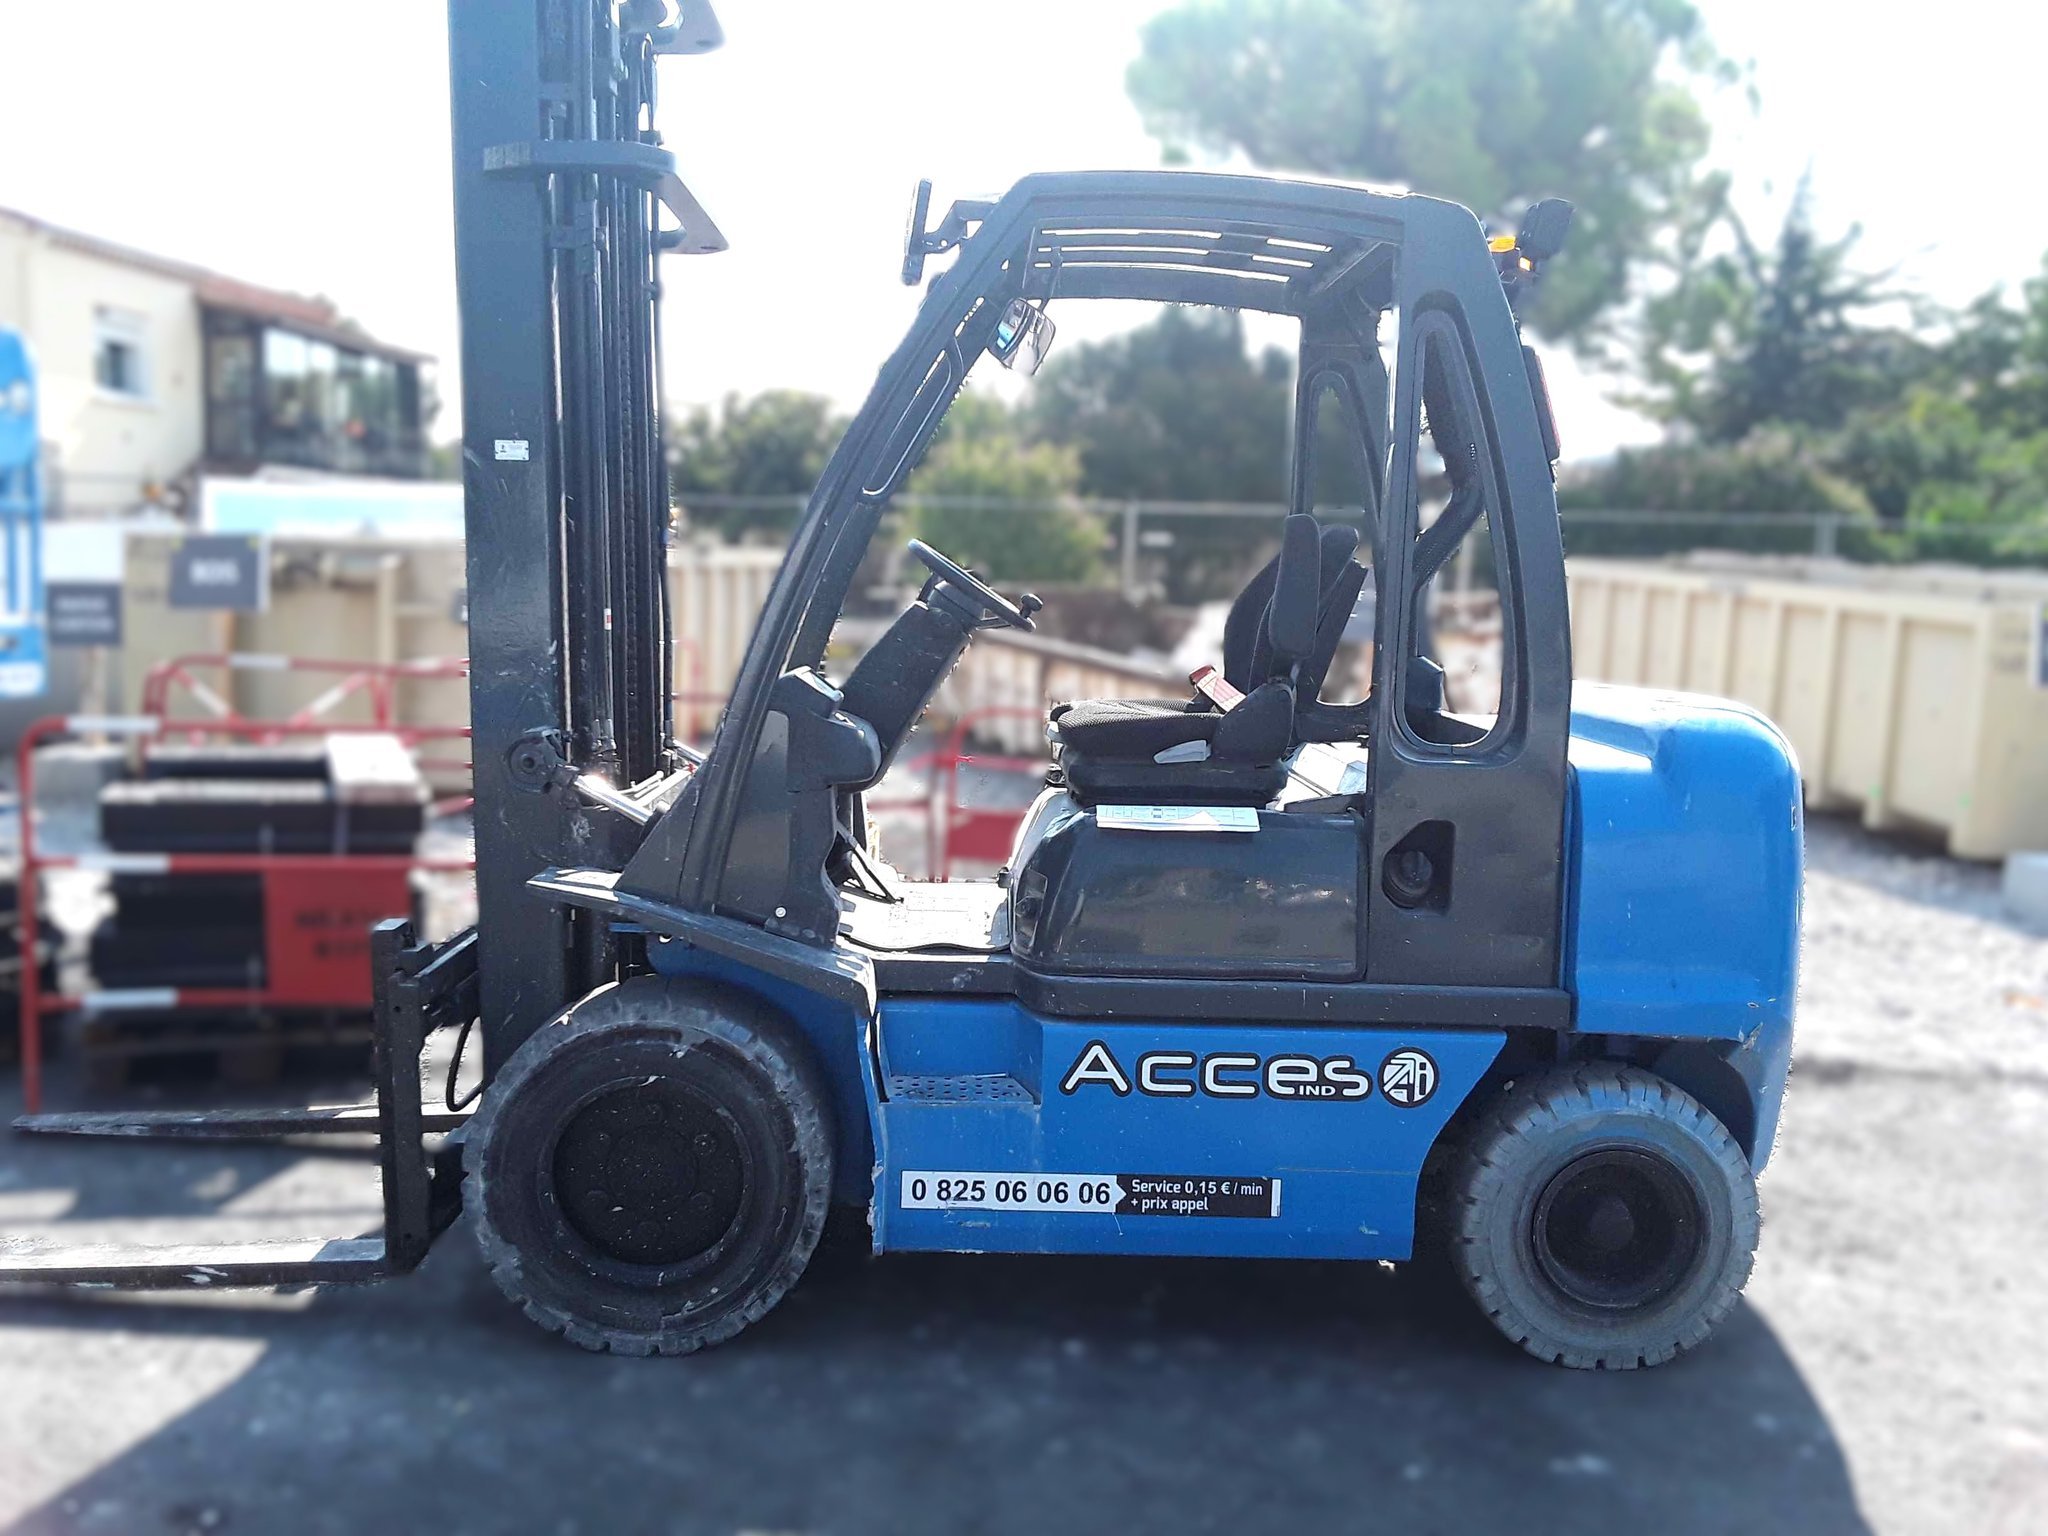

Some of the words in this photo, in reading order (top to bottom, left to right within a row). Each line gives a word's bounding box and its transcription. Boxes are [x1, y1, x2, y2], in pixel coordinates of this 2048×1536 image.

[1299, 1085, 1336, 1096] IND
[911, 1178, 928, 1201] 0
[936, 1179, 986, 1202] 825
[995, 1180, 1028, 1203] 06
[1037, 1181, 1069, 1204] 06
[1078, 1182, 1111, 1205] 06
[1131, 1179, 1181, 1194] Service
[1184, 1181, 1217, 1196] 0,15
[1220, 1181, 1231, 1195] €
[1240, 1183, 1263, 1196] min
[1131, 1198, 1138, 1207] +
[1141, 1196, 1168, 1213] prix
[1171, 1197, 1209, 1214] appel
